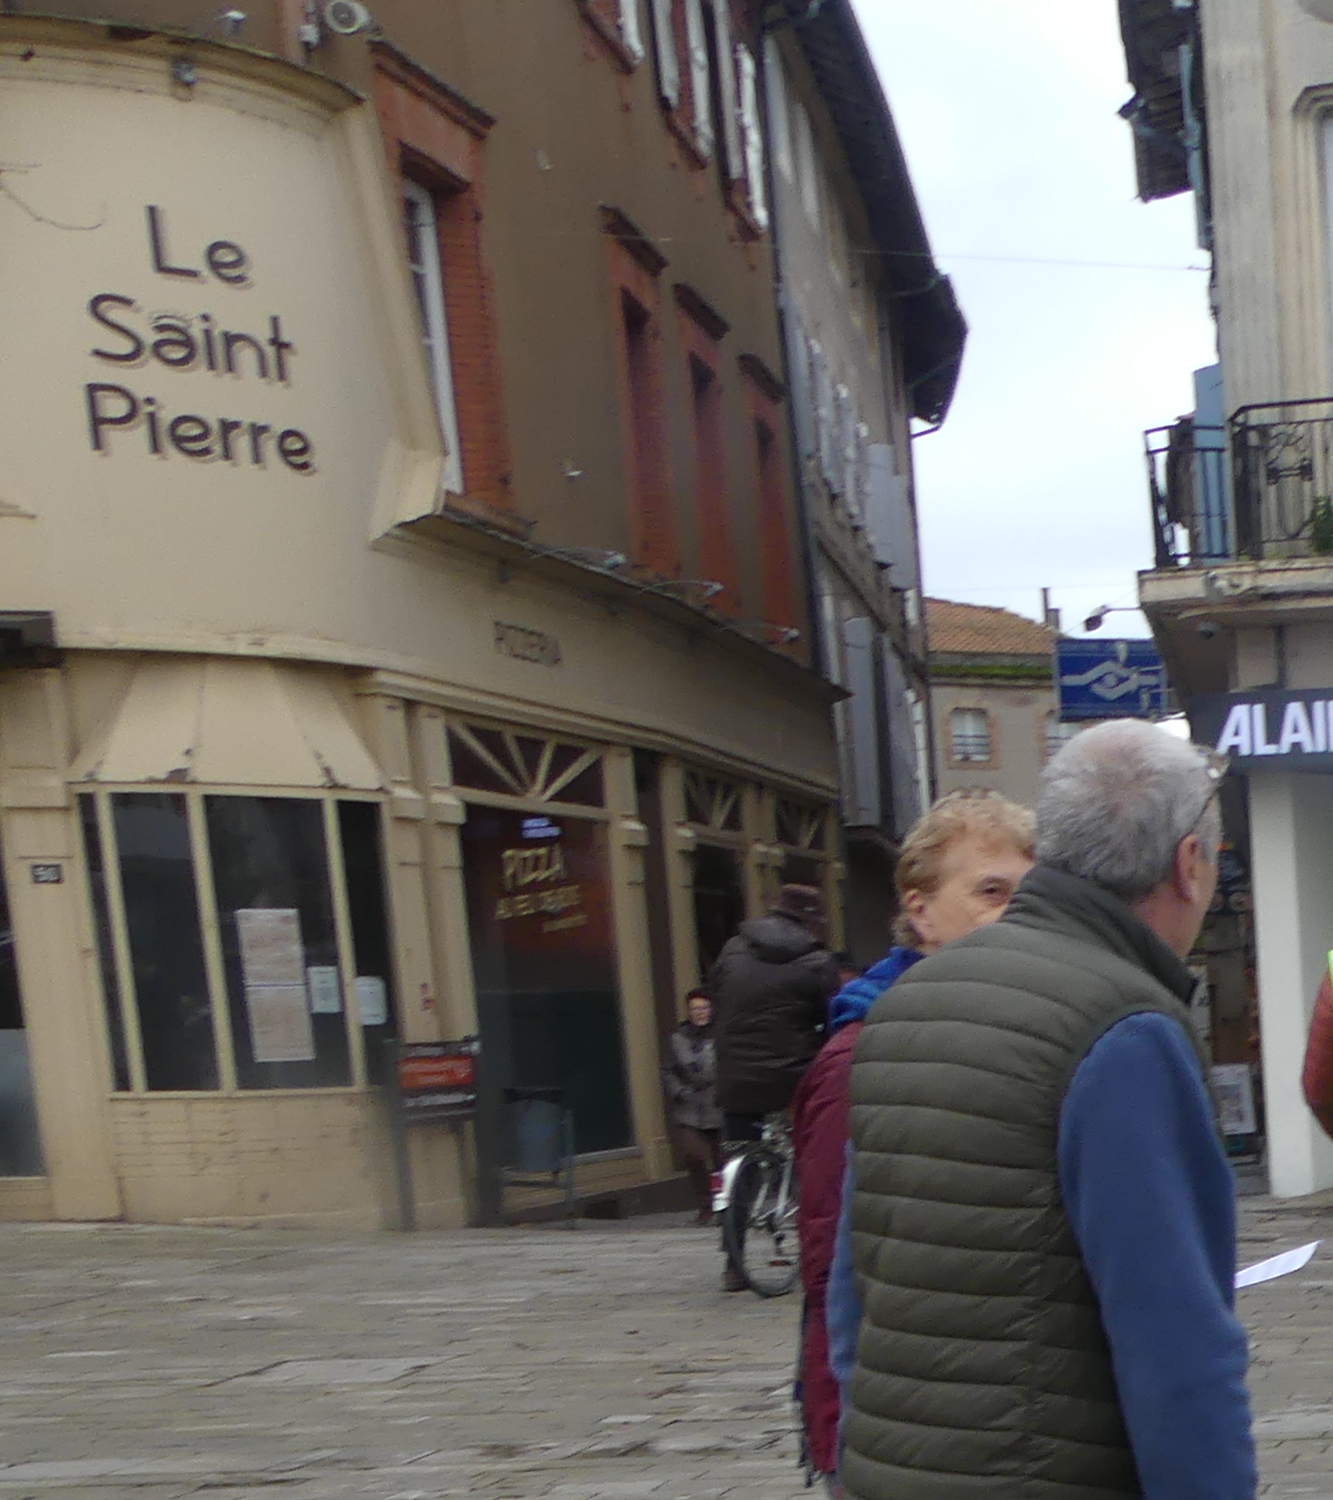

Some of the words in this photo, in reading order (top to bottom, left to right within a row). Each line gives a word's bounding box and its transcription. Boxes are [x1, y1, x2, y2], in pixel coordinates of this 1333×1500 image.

[147, 205, 249, 285] Le
[88, 293, 293, 381] Saint
[86, 383, 312, 472] Pierre
